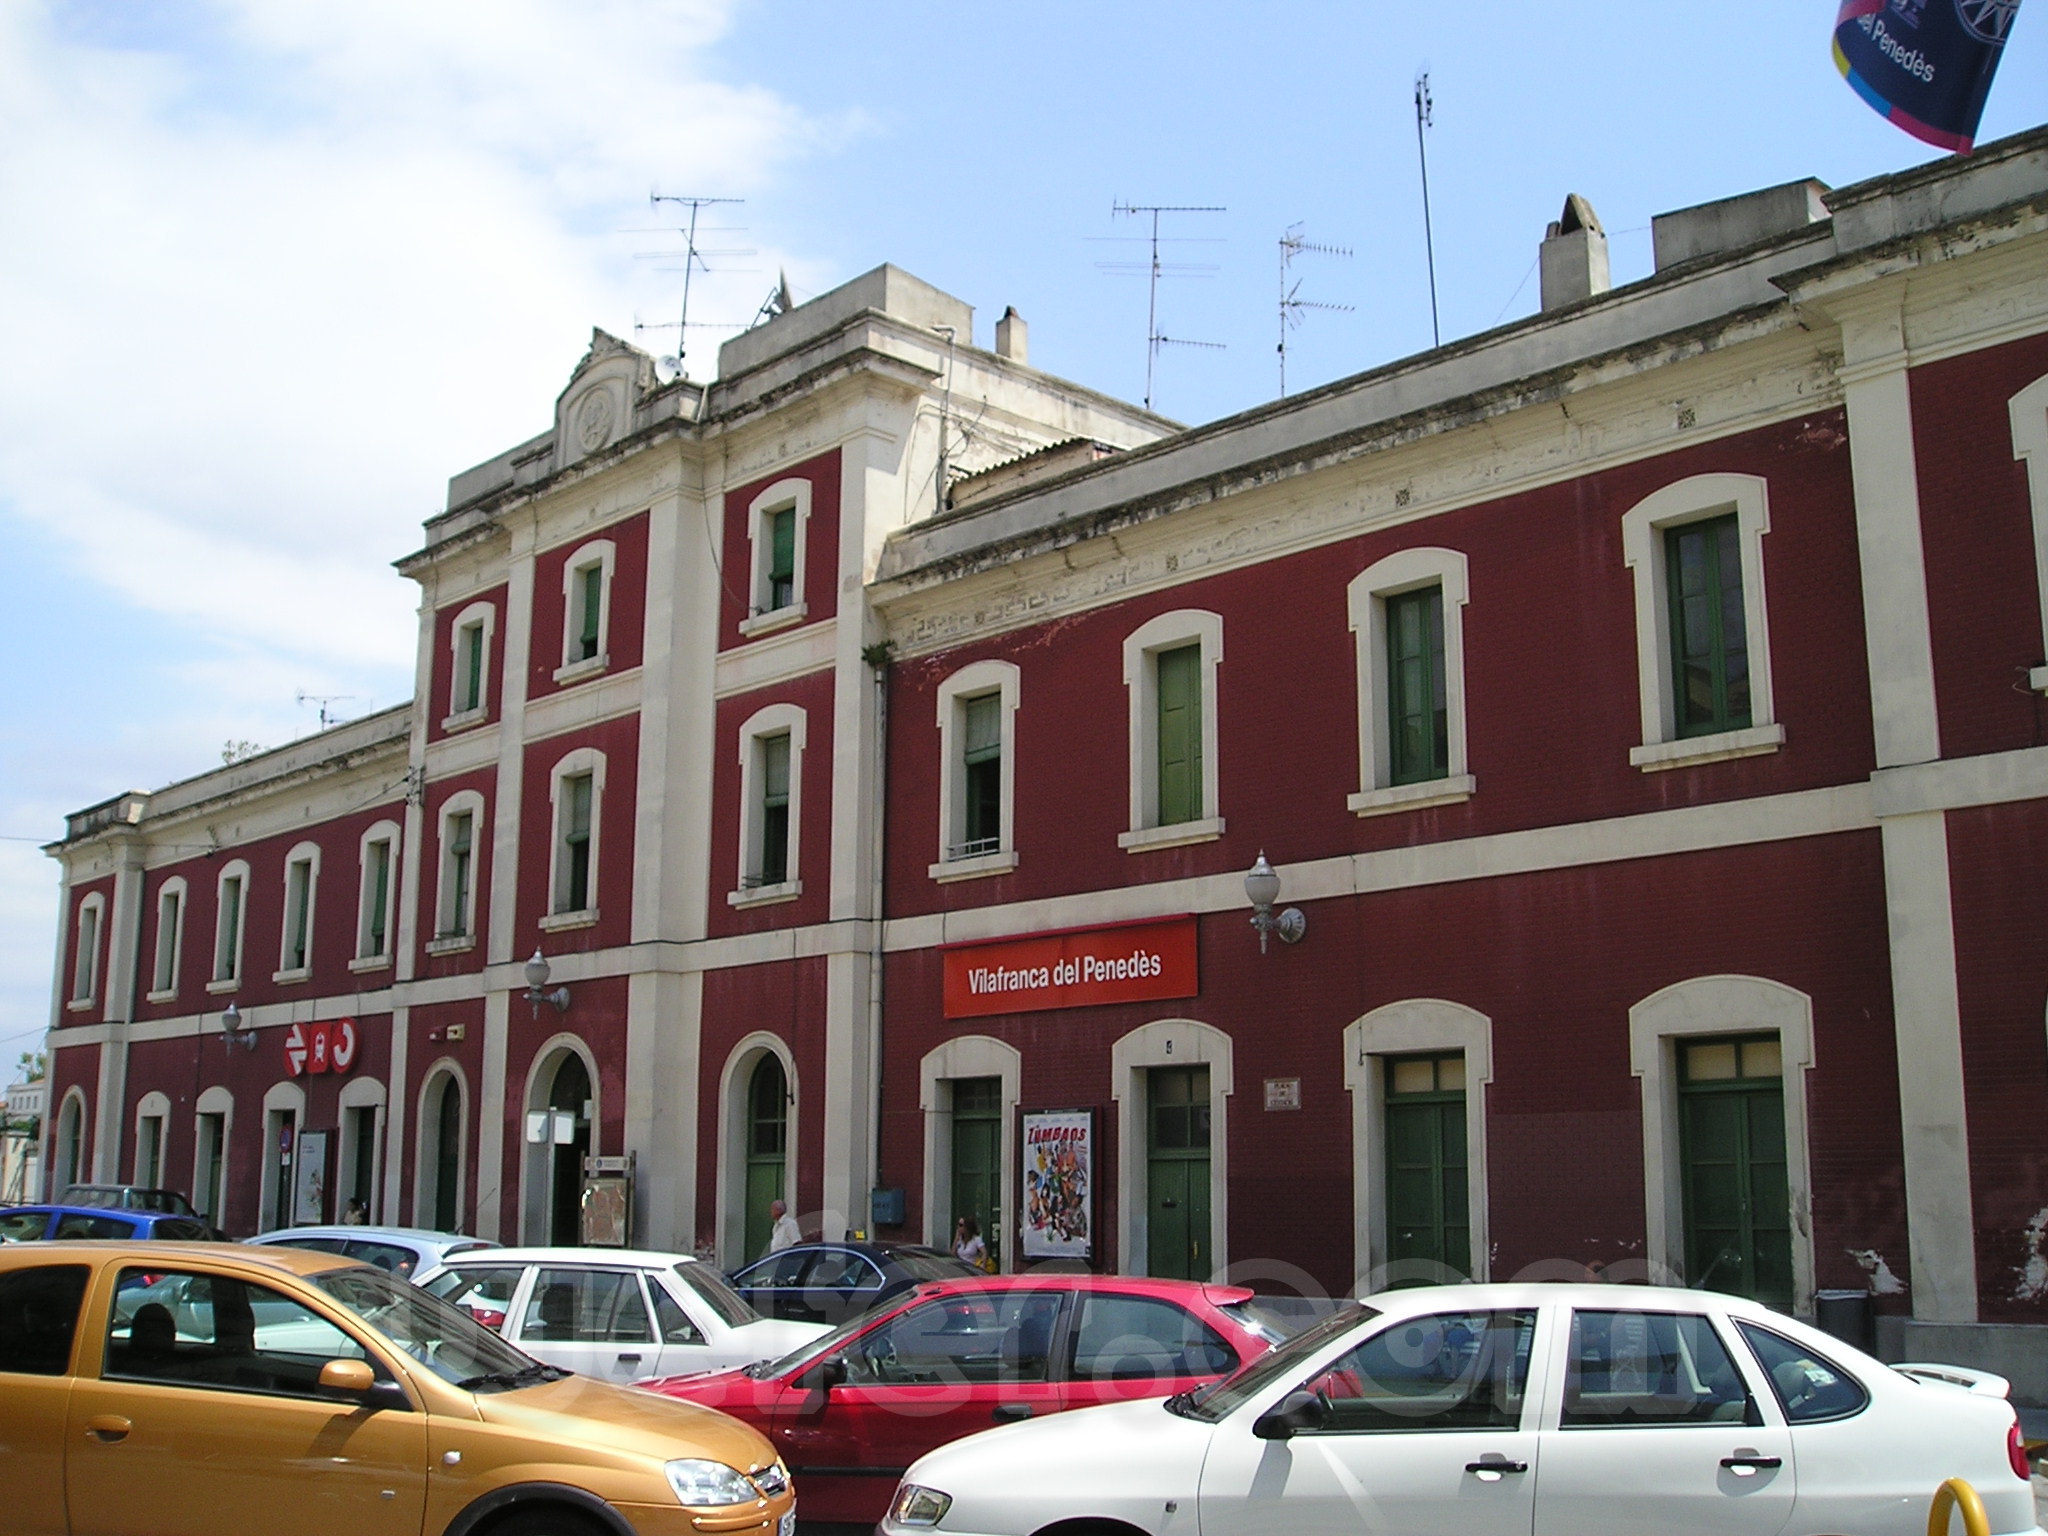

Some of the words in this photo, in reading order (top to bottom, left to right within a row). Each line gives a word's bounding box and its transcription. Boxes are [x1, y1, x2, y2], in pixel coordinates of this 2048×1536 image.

[1856, 12, 1876, 35] el
[1871, 19, 1936, 83] Penedès
[967, 965, 1050, 995] Vilafranca
[1053, 957, 1080, 987] del
[1083, 949, 1162, 983] Penedès
